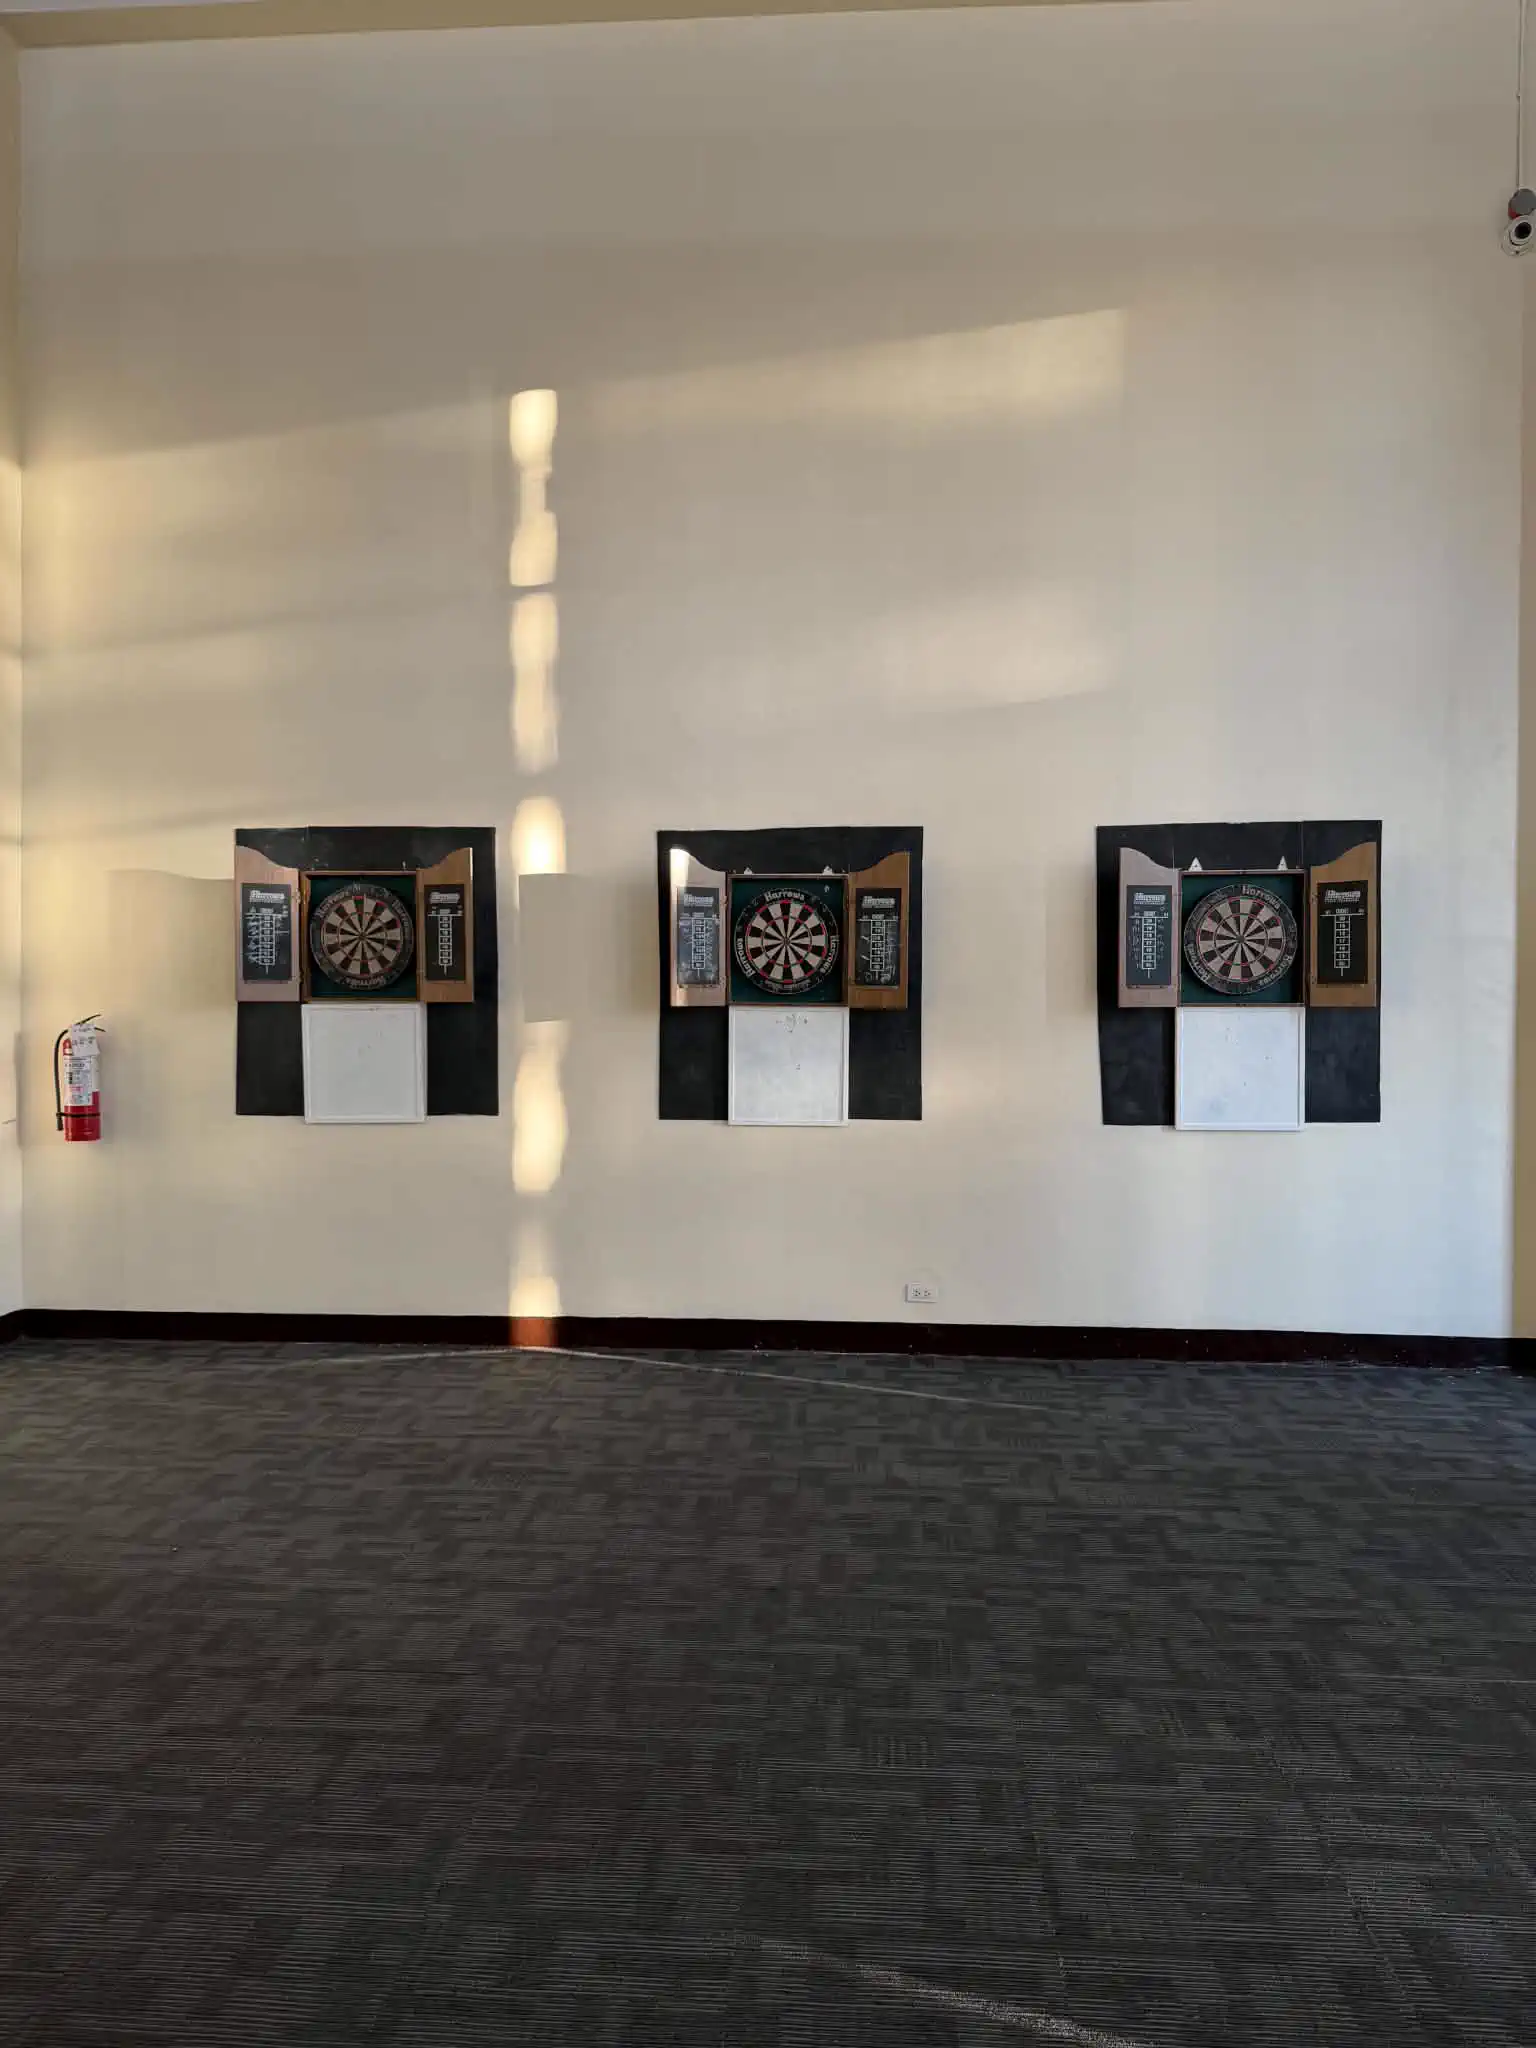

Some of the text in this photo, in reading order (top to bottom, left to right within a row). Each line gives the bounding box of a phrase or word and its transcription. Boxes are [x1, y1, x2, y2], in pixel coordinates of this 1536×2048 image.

[764, 891, 805, 902] Harrows
[1241, 884, 1281, 910] Harrows
[736, 938, 756, 977] Harrows
